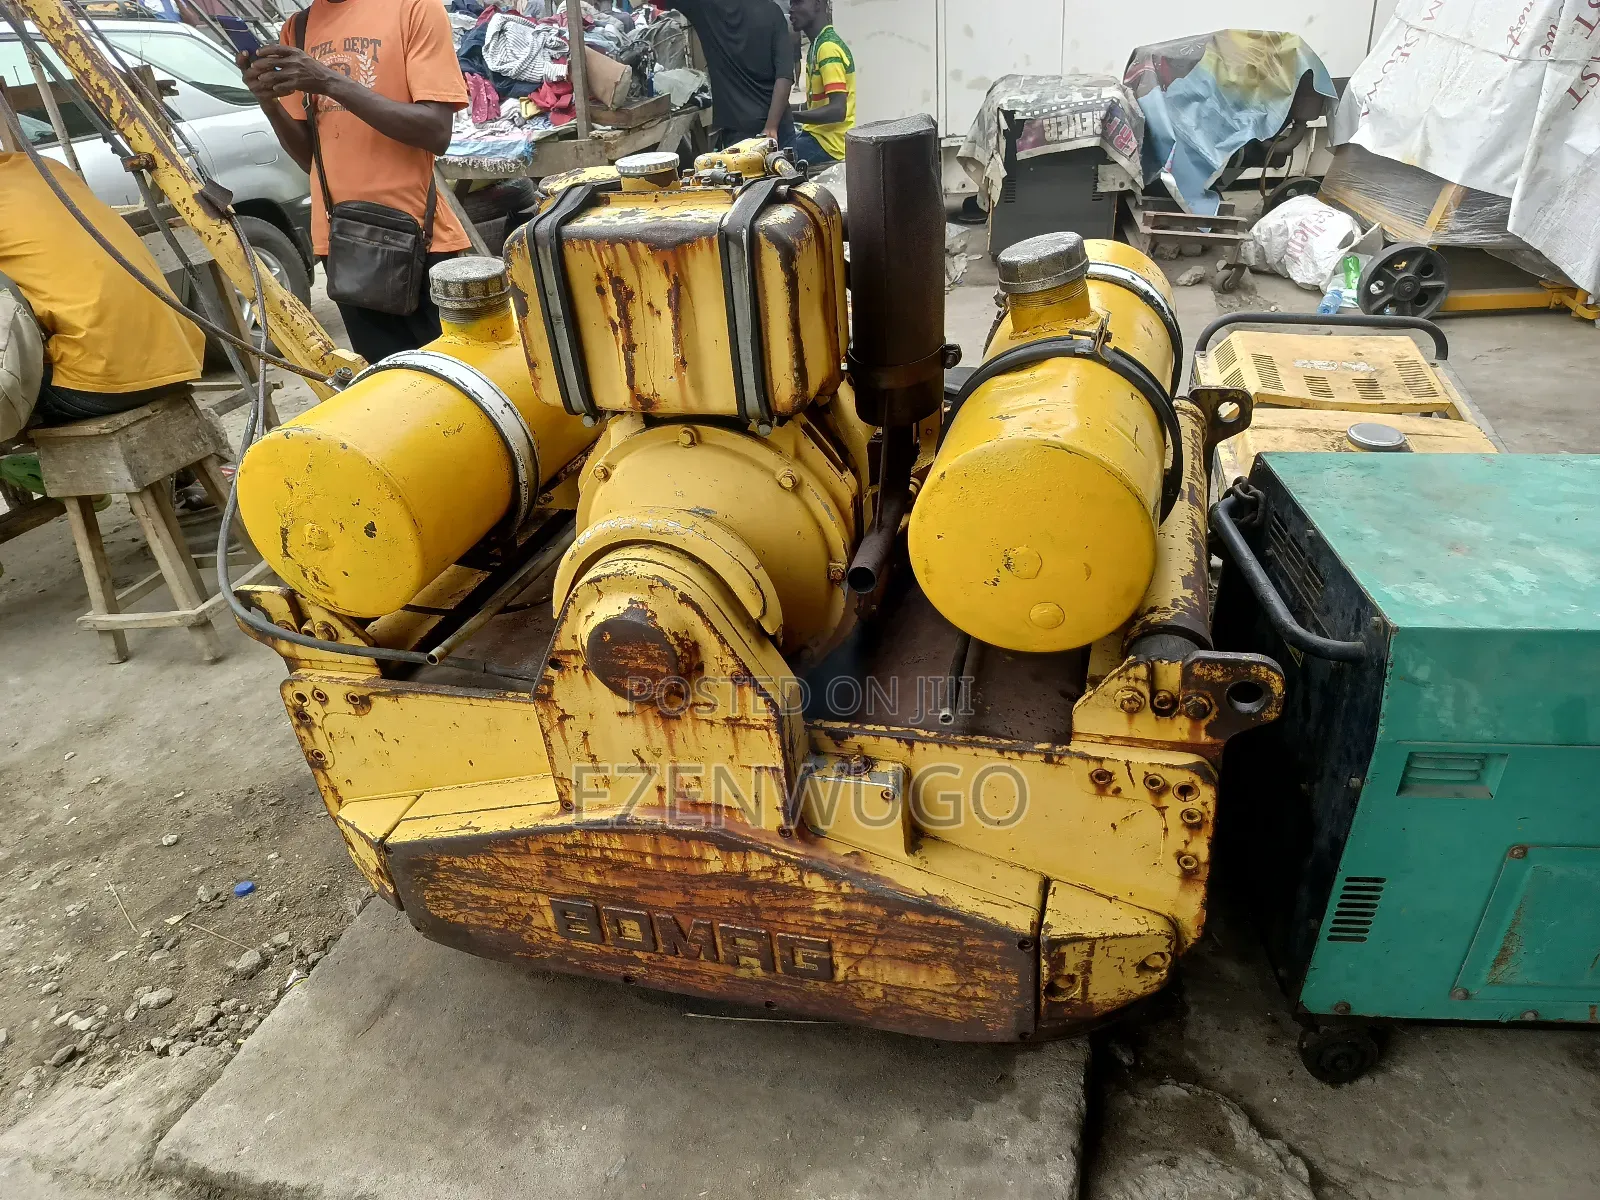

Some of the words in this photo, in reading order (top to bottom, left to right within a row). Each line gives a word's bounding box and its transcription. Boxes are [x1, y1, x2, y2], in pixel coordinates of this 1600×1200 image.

[343, 36, 382, 63] DEPT
[1564, 55, 1600, 110] ST
[549, 897, 833, 980] BOMAG
